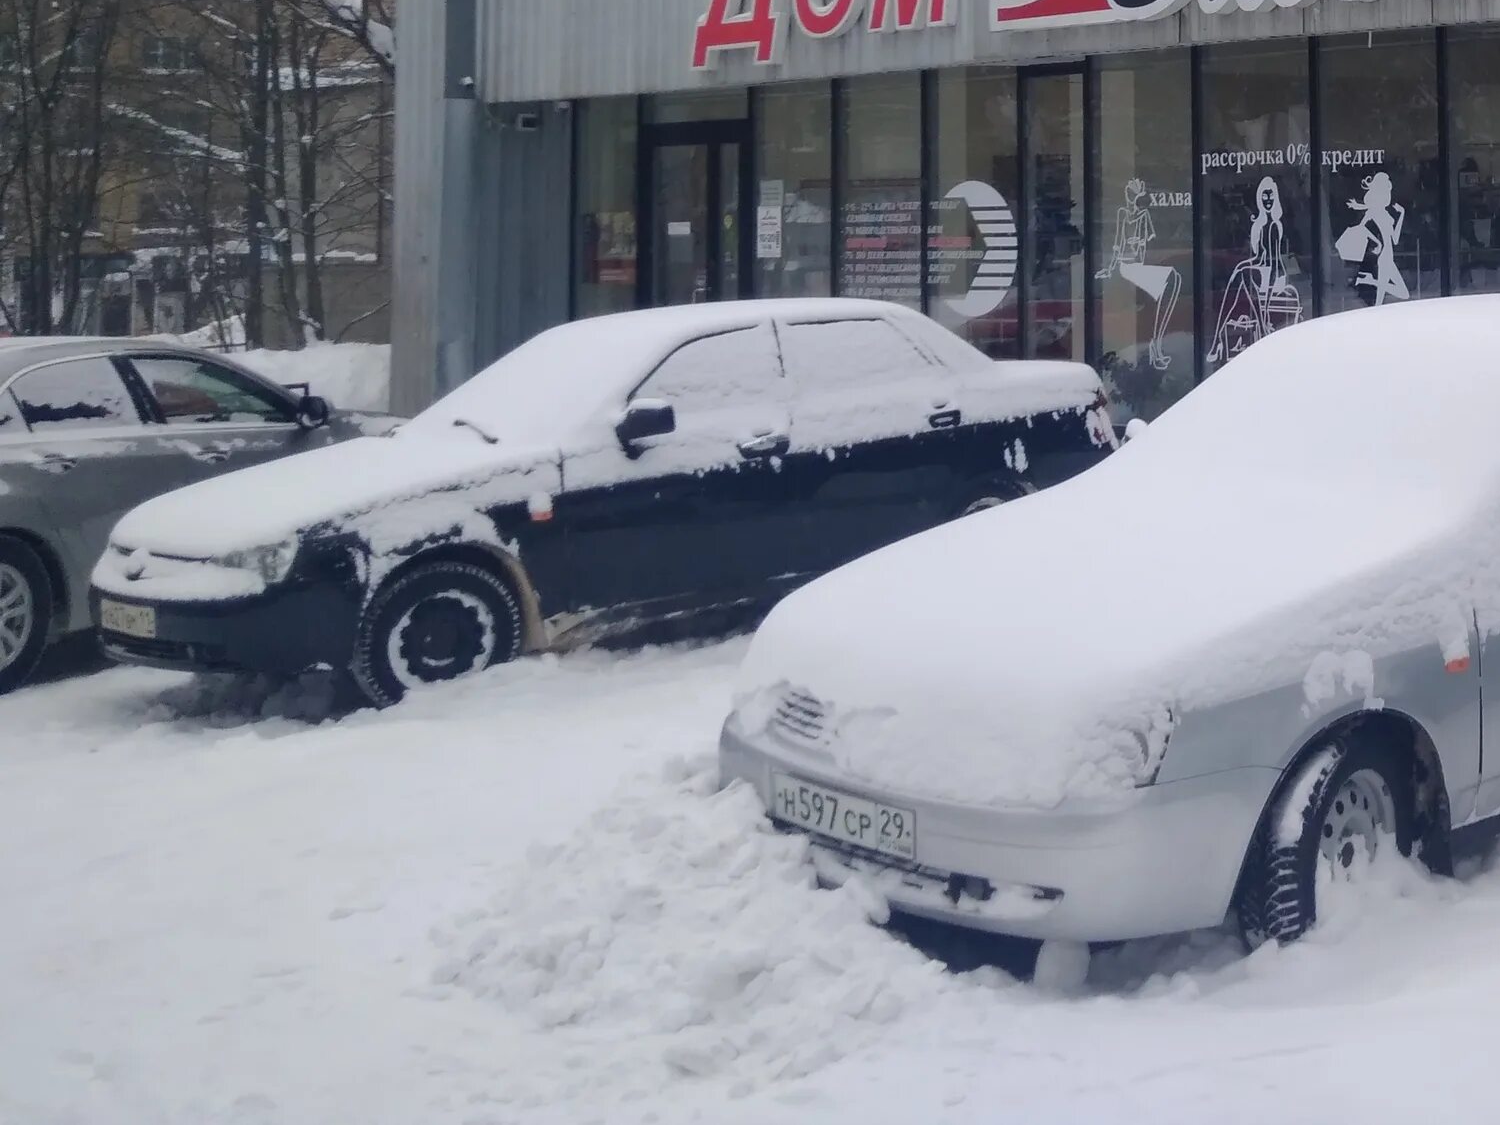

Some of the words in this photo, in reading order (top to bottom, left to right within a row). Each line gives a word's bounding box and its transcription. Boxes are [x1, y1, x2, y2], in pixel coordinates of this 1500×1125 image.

[1201, 147, 1284, 174] рассрочка
[1286, 143, 1311, 166] 0%
[1321, 148, 1385, 173] кредит
[1149, 191, 1192, 207] халва
[879, 808, 905, 840] 29
